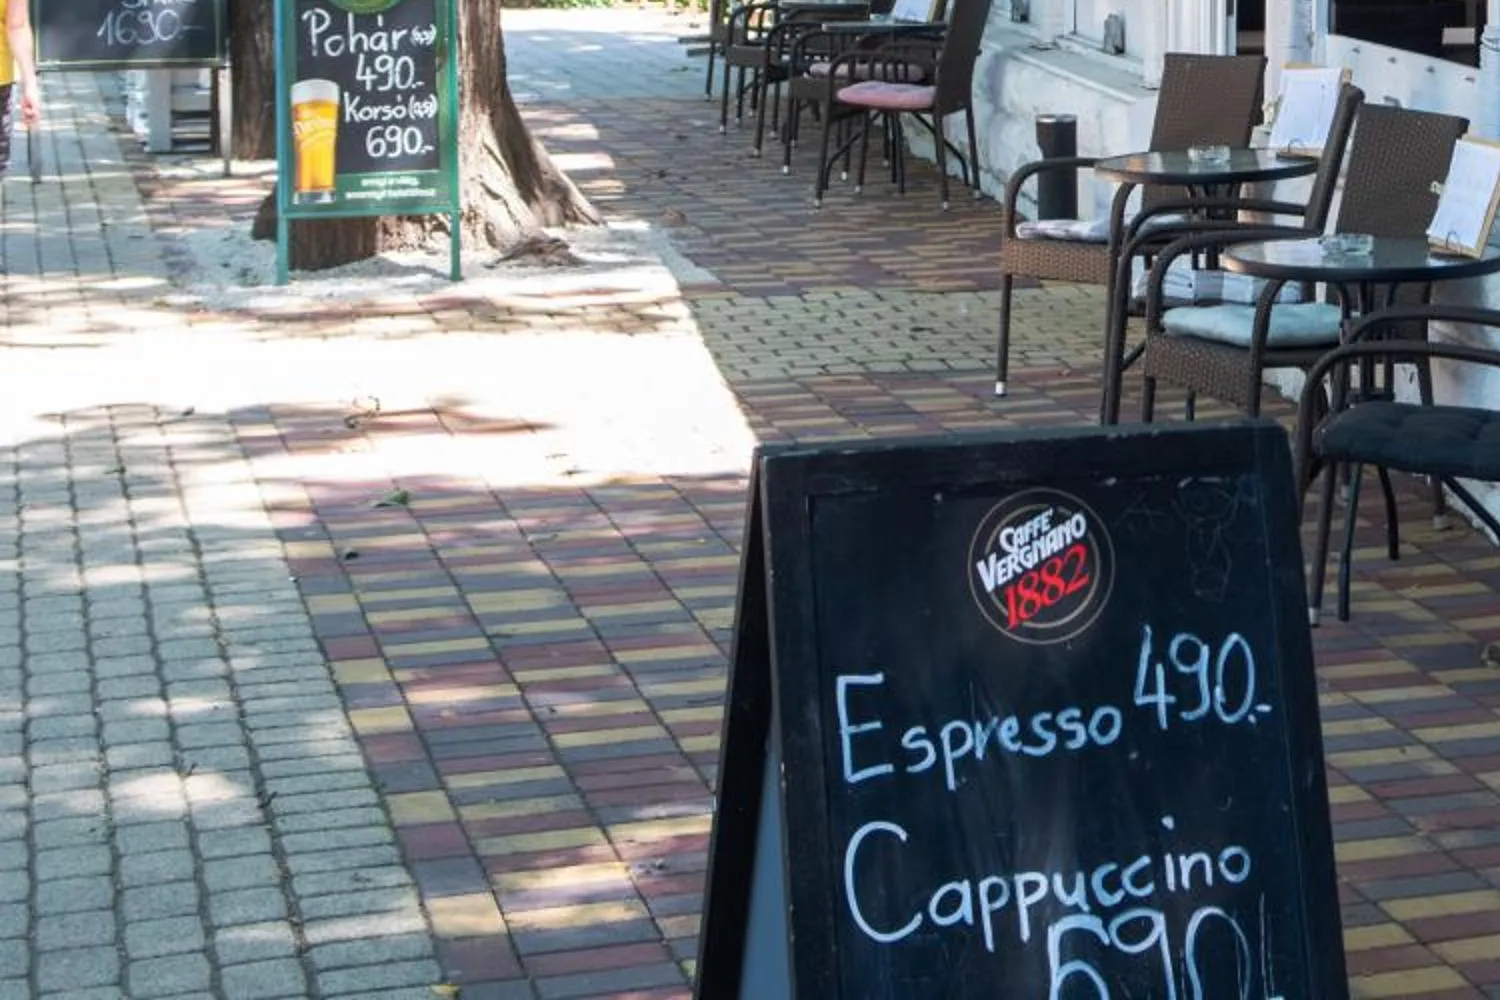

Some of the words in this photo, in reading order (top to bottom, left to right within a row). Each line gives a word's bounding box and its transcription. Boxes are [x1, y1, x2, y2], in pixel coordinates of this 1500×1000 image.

[301, 8, 407, 57] Pohár
[343, 91, 407, 123] Korsó
[1003, 543, 1089, 631] 1882
[835, 672, 1123, 790] Espresso
[844, 815, 1252, 952] Cappuccino
